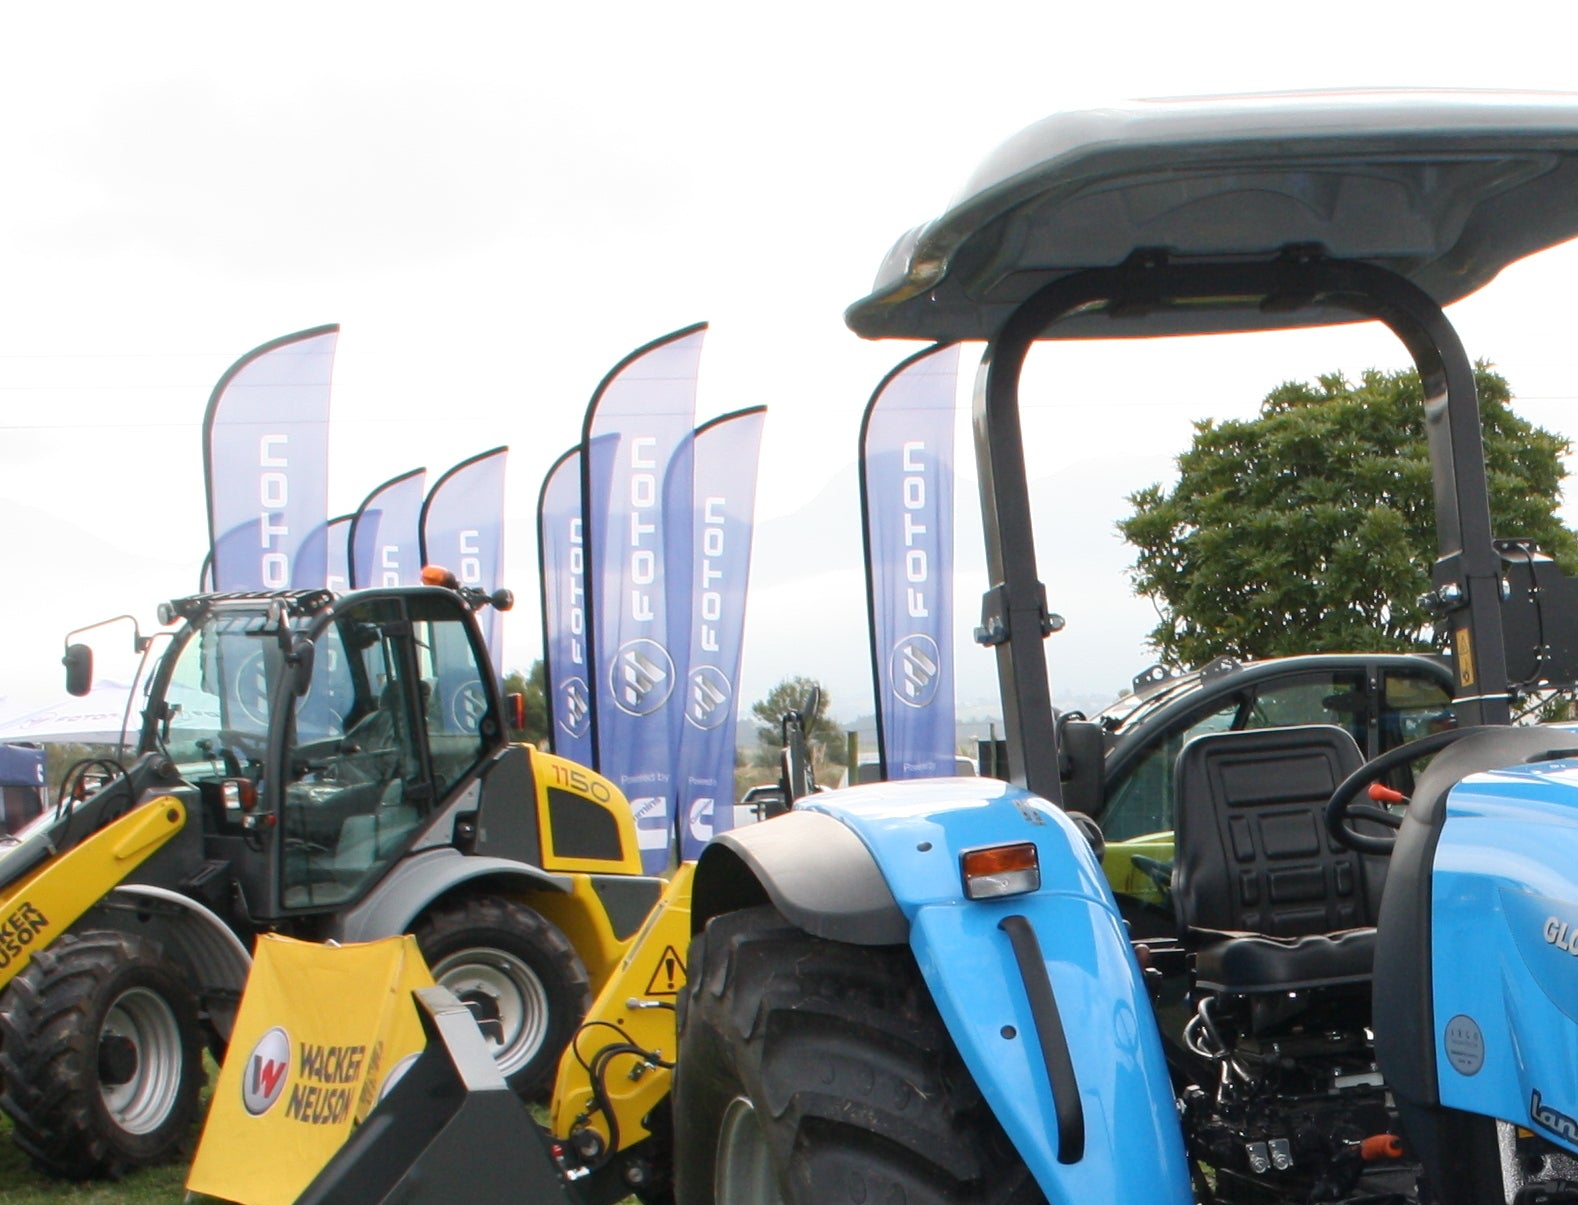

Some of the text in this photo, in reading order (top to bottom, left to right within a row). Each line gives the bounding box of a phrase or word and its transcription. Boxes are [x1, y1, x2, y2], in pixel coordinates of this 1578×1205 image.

[260, 434, 289, 589] OTON
[631, 437, 657, 621] FOTON
[702, 496, 726, 652] FOTON
[903, 441, 929, 618] FOTON
[570, 518, 584, 664] FOTON
[551, 764, 610, 802] 1150
